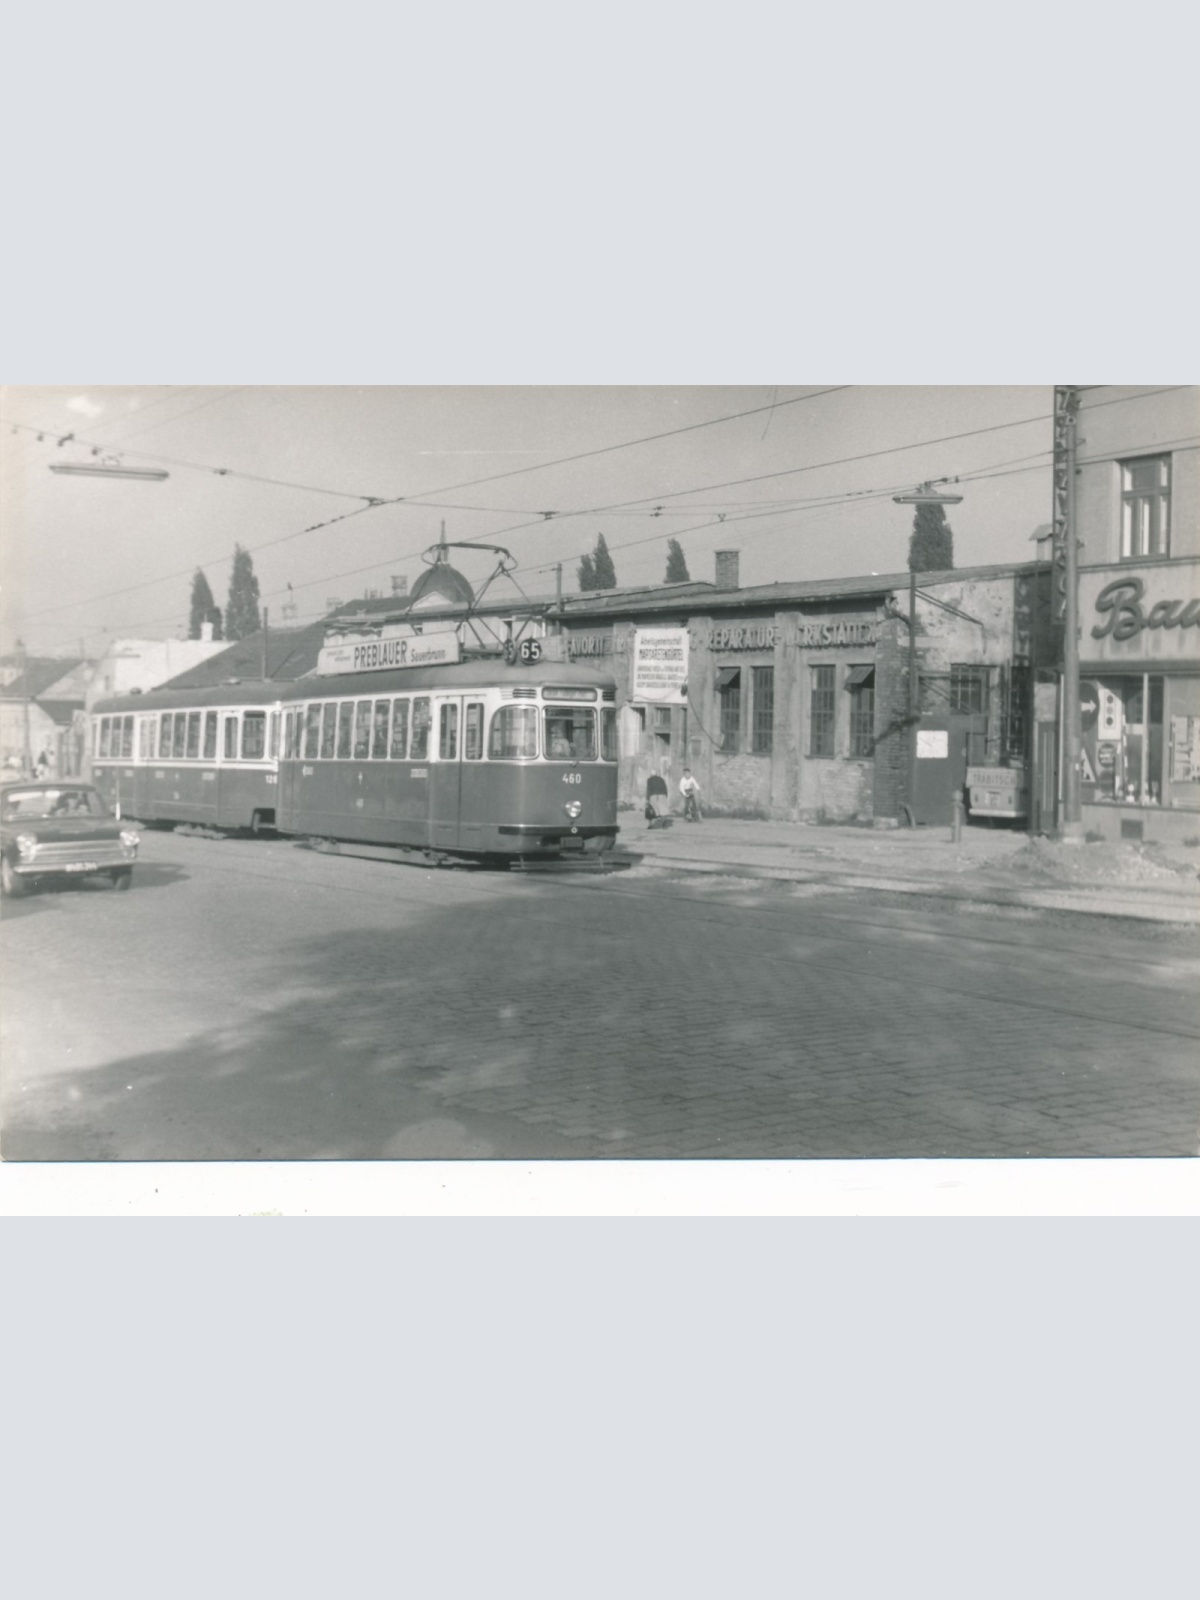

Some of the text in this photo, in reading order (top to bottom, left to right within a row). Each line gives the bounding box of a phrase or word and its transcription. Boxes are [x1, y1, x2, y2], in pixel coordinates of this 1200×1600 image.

[354, 640, 408, 669] PREBLAUER
[521, 642, 540, 659] 65
[562, 773, 582, 784] 460
